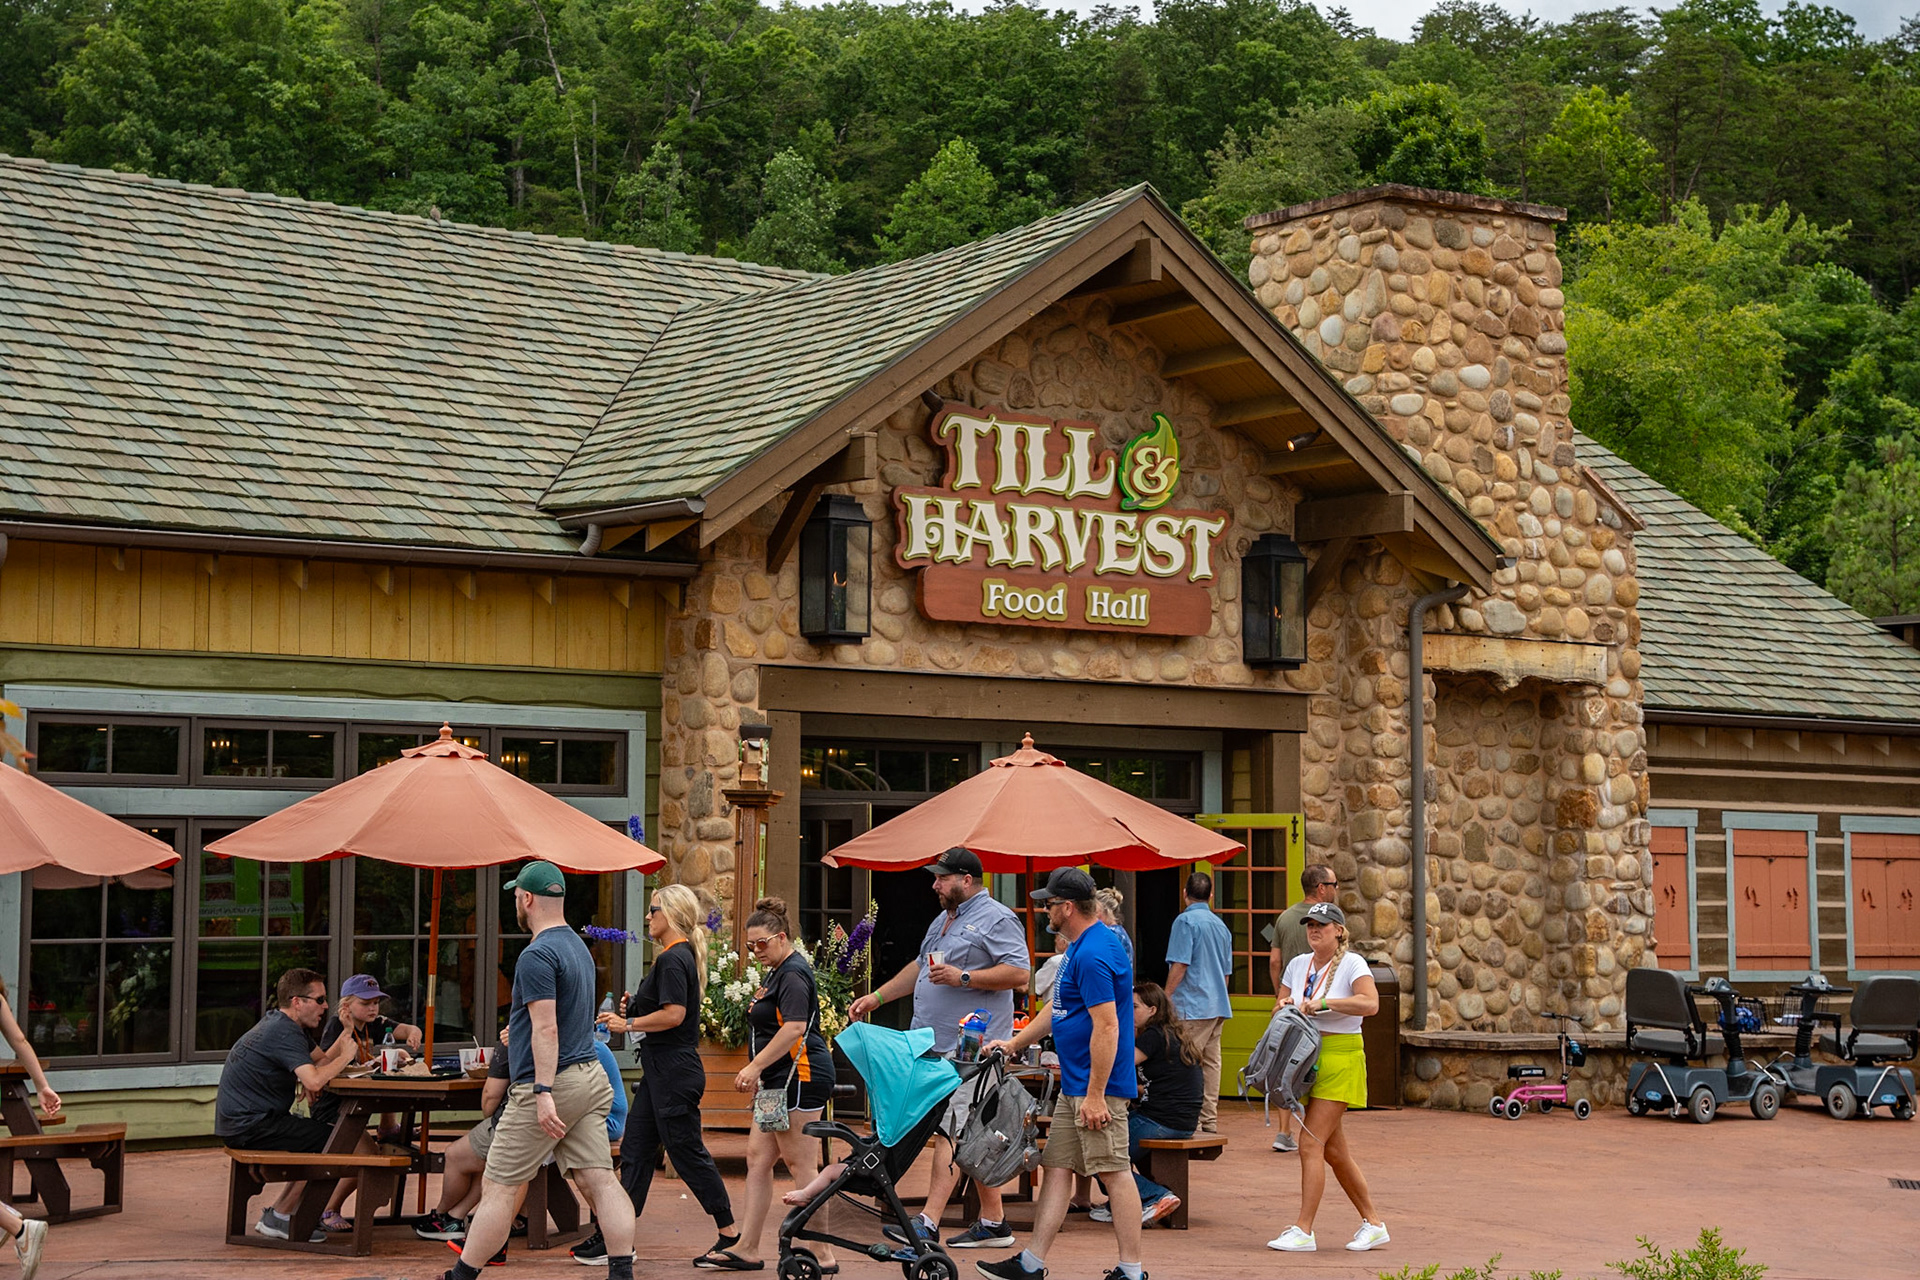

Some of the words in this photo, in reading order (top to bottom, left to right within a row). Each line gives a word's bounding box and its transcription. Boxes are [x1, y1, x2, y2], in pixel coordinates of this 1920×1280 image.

[940, 413, 1116, 499] TILL
[1130, 445, 1176, 496] &
[902, 493, 1226, 582] HARVEST
[986, 583, 1065, 616] Food
[1090, 590, 1147, 621] Hall
